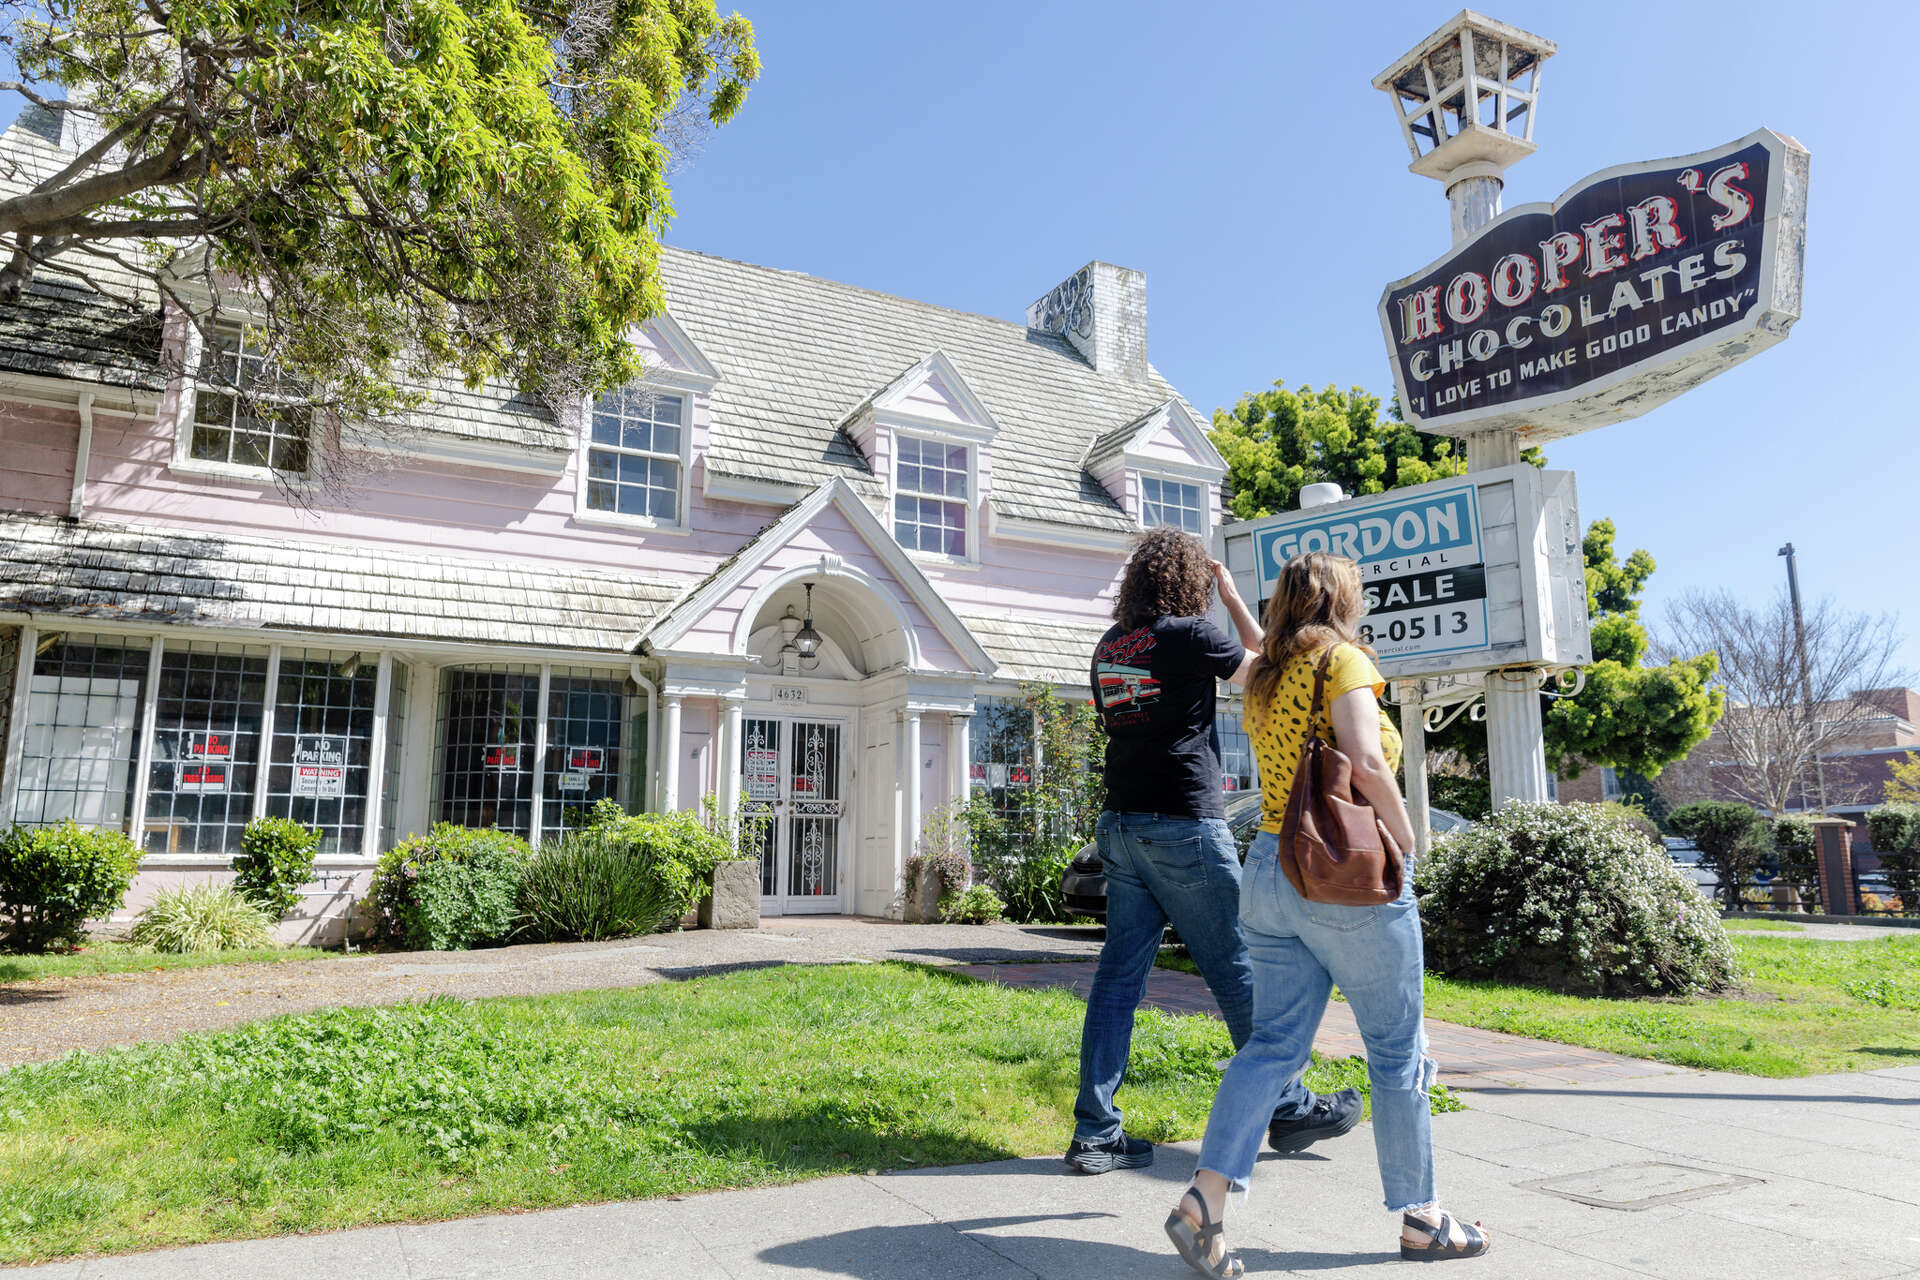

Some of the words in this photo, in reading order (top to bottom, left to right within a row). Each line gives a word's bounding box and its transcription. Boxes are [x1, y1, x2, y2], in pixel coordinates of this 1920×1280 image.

[1397, 162, 1754, 345] HOOPER'S
[1409, 240, 1747, 381] CHOCOLATES
[1435, 378, 1481, 407] LOVE
[1486, 368, 1512, 391] TO
[1519, 347, 1576, 381] MAKE
[1585, 323, 1651, 360] GOOD
[1271, 502, 1460, 568] GORDON
[1359, 552, 1449, 577] ERCIAL
[1362, 573, 1455, 610] SALE
[1359, 610, 1469, 646] 8-0513
[777, 689, 802, 700] 4632
[193, 743, 229, 755] PAKING
[315, 740, 331, 751] NO
